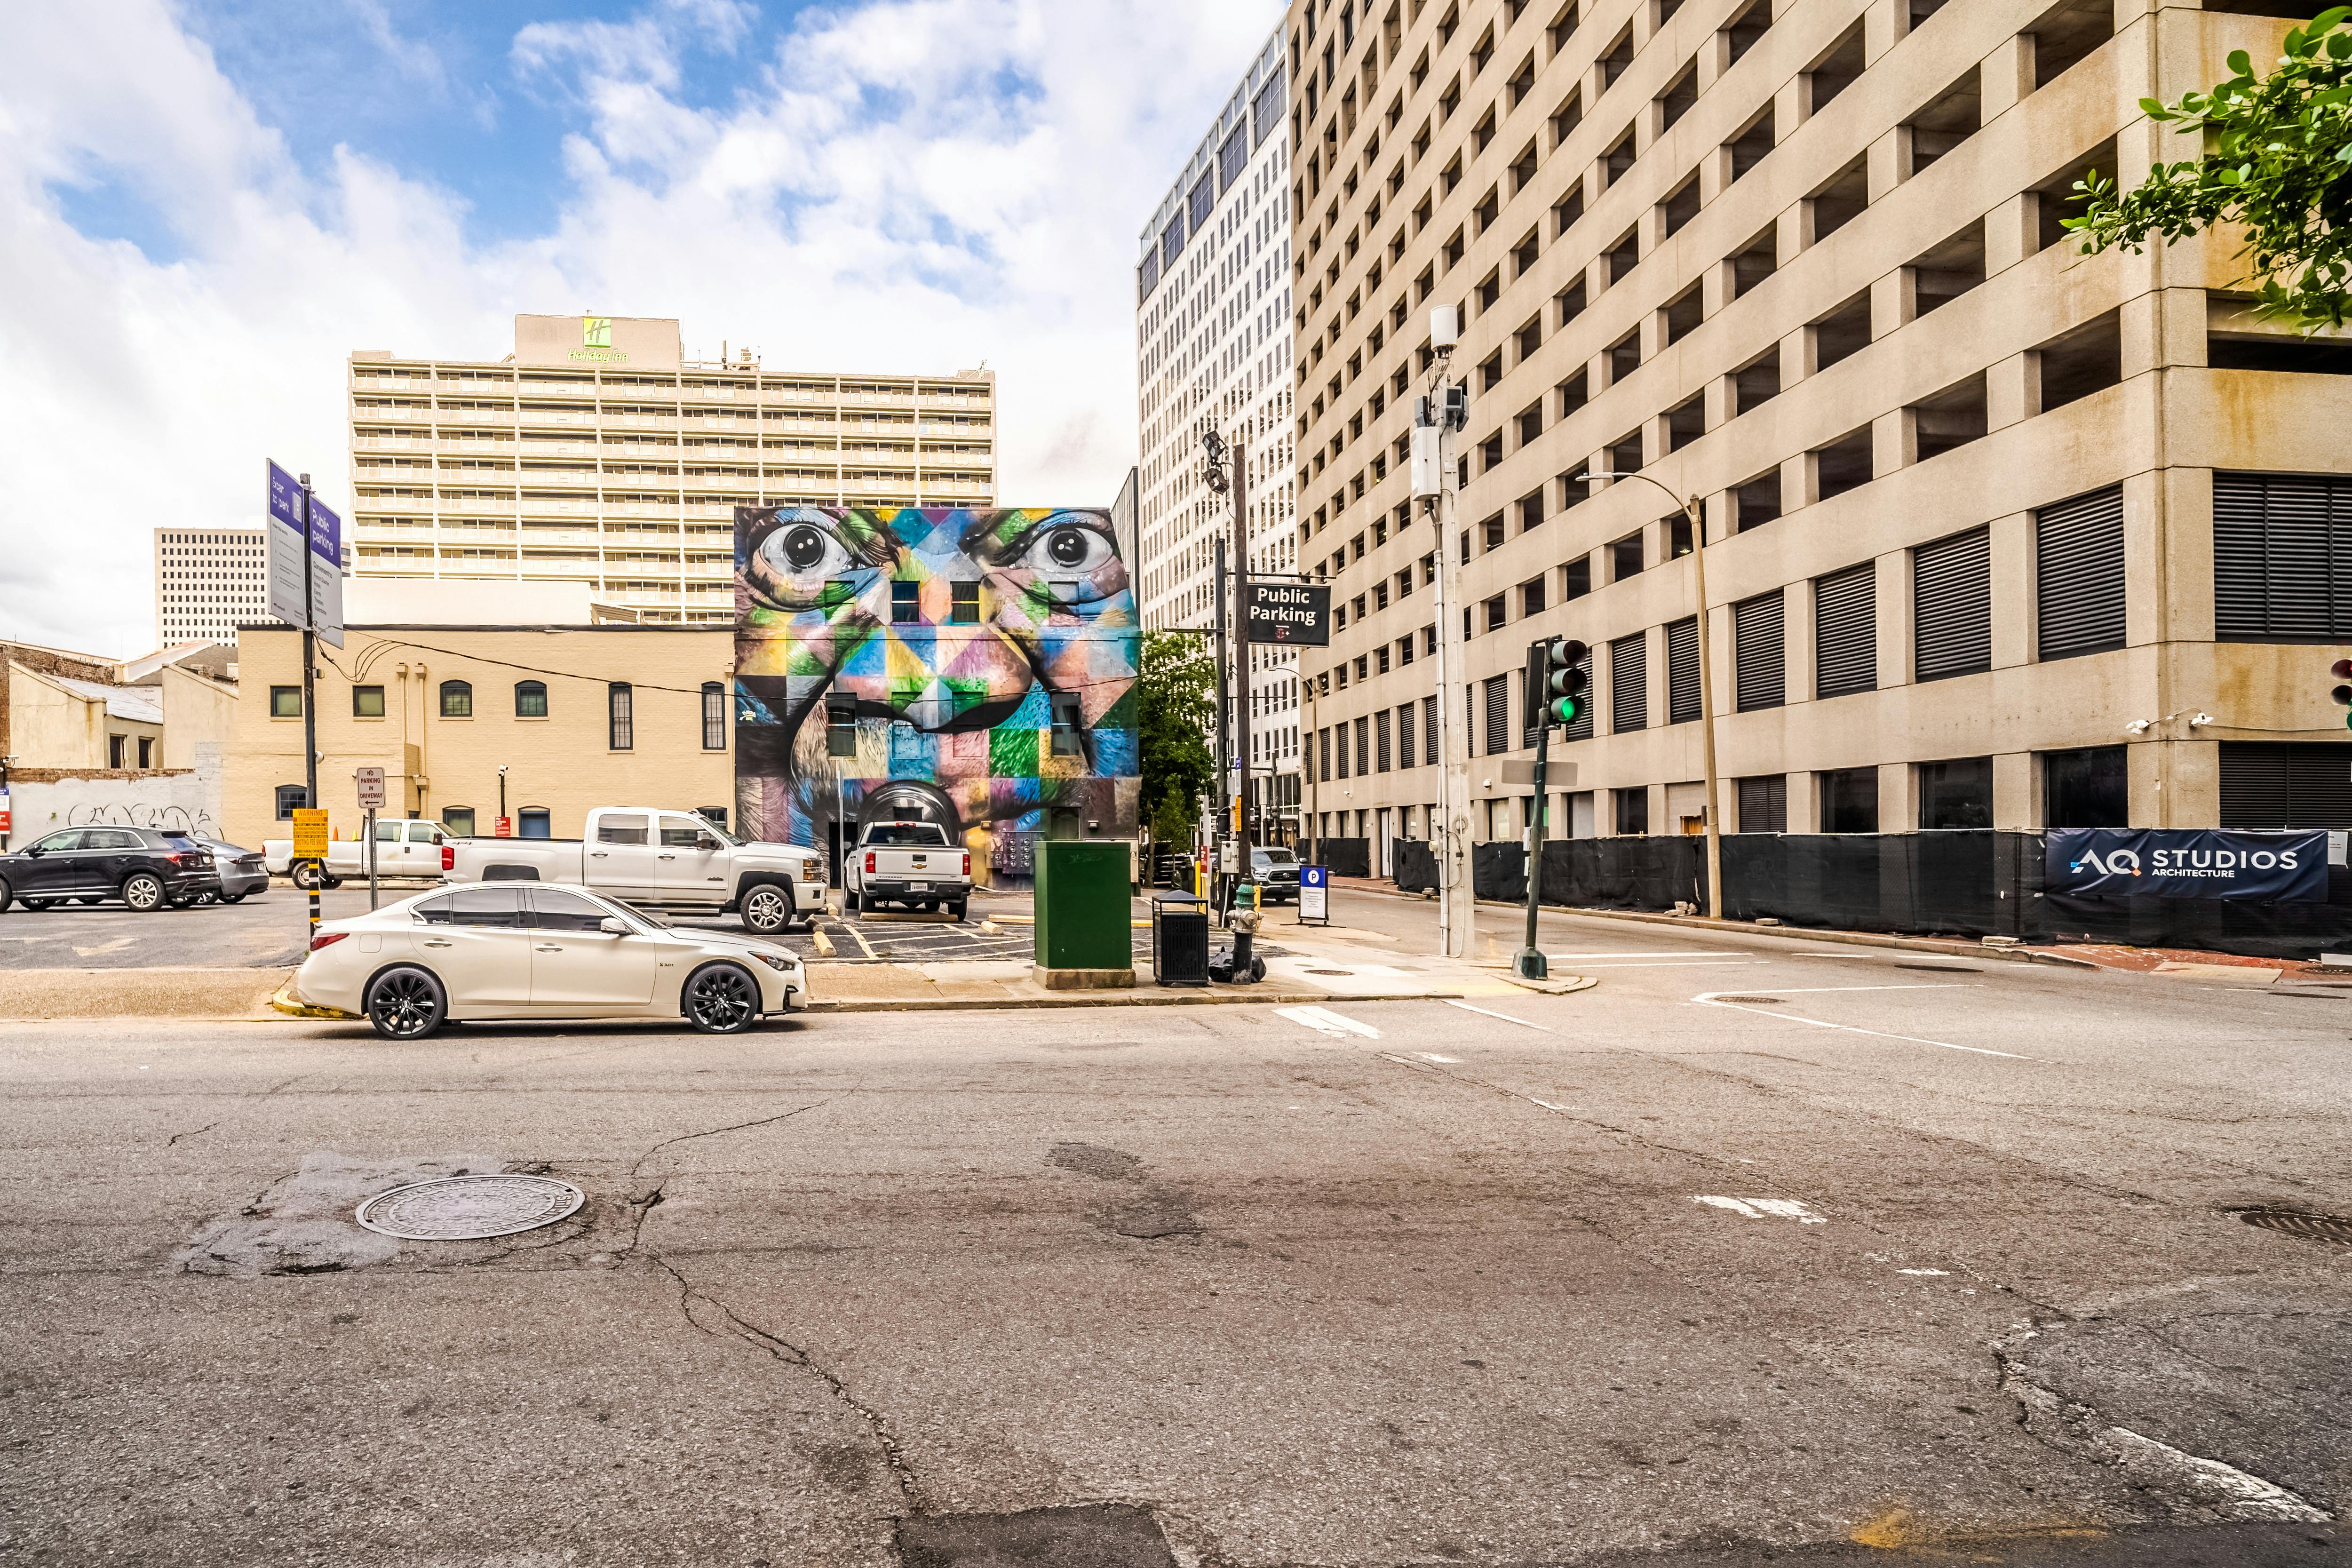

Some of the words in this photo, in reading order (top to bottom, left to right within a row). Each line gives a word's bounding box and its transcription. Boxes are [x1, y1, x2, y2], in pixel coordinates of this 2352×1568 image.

[567, 348, 610, 365] Holiday
[612, 347, 629, 363] Inn
[271, 475, 285, 496] Scan
[271, 491, 278, 505] to
[278, 498, 290, 514] park
[312, 508, 330, 533] Public
[312, 529, 334, 556] parking
[1258, 588, 1310, 604] Public
[1250, 605, 1316, 626] Parking
[2071, 849, 2141, 877] AQ
[2152, 850, 2298, 870] STUDIOS
[2152, 868, 2235, 878] ARCHITECTURE
